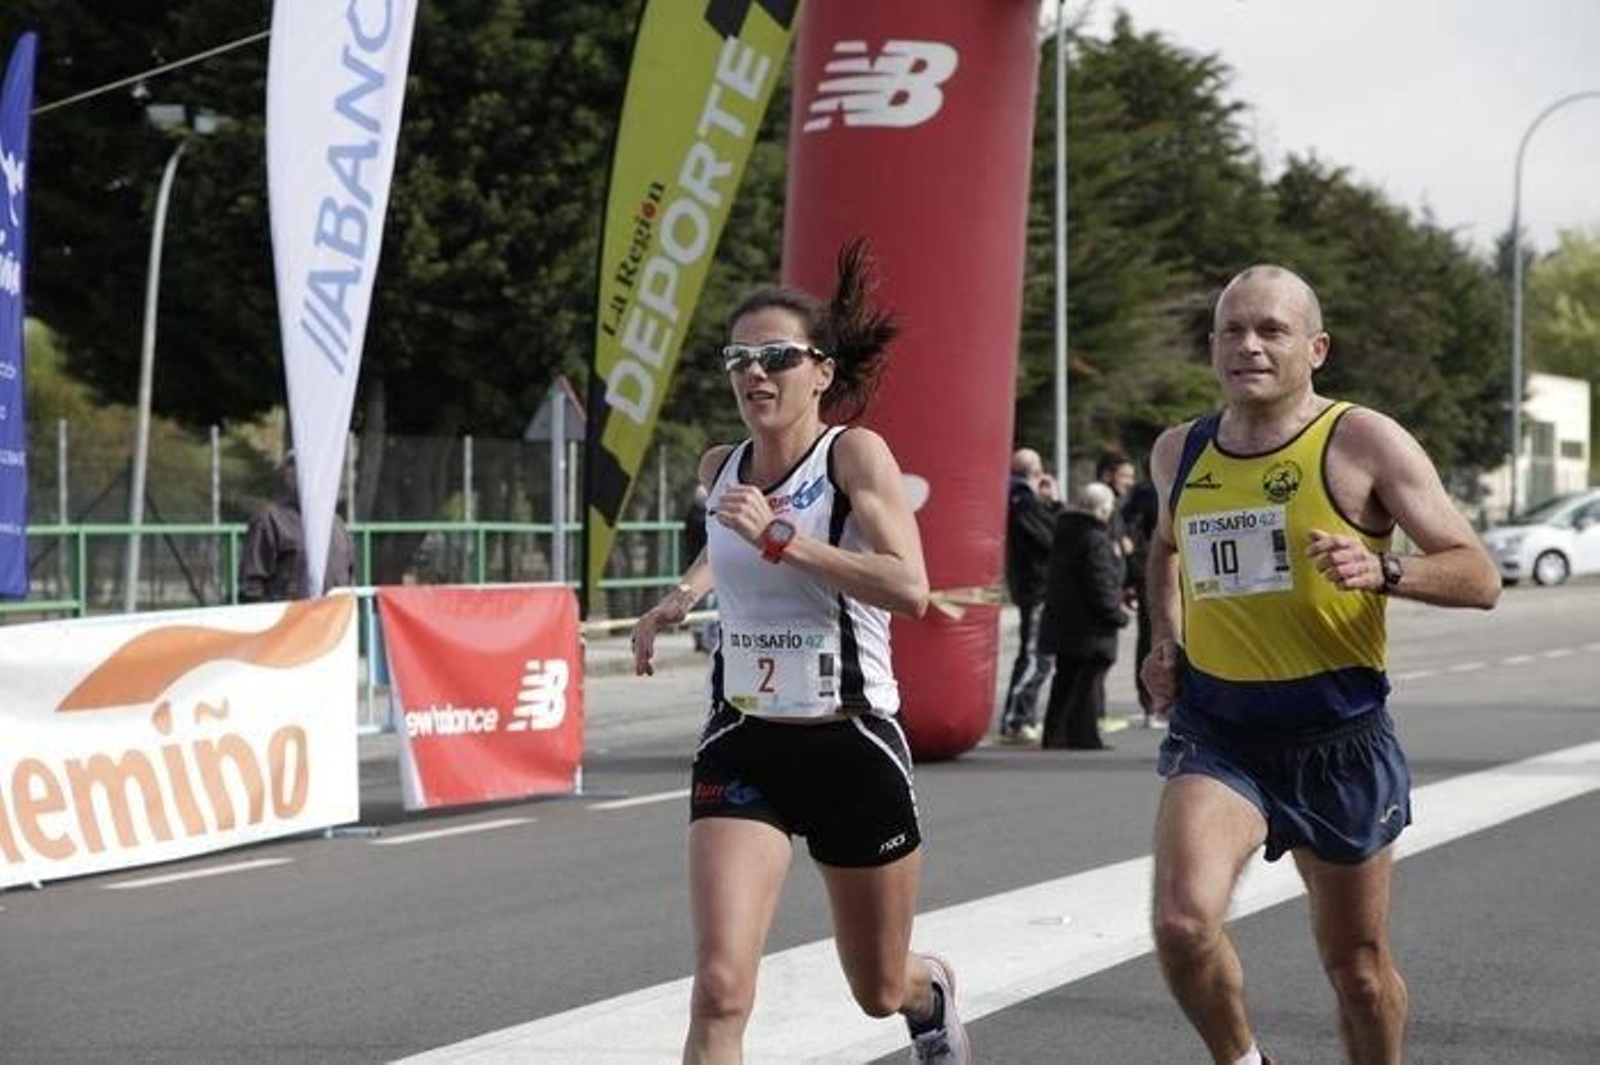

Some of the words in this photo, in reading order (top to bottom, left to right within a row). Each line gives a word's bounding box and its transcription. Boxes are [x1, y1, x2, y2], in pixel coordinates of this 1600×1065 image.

[605, 35, 771, 425] DEPORTE
[1211, 539, 1240, 576] 10
[758, 657, 776, 694] 2
[0, 698, 309, 865] emiño
